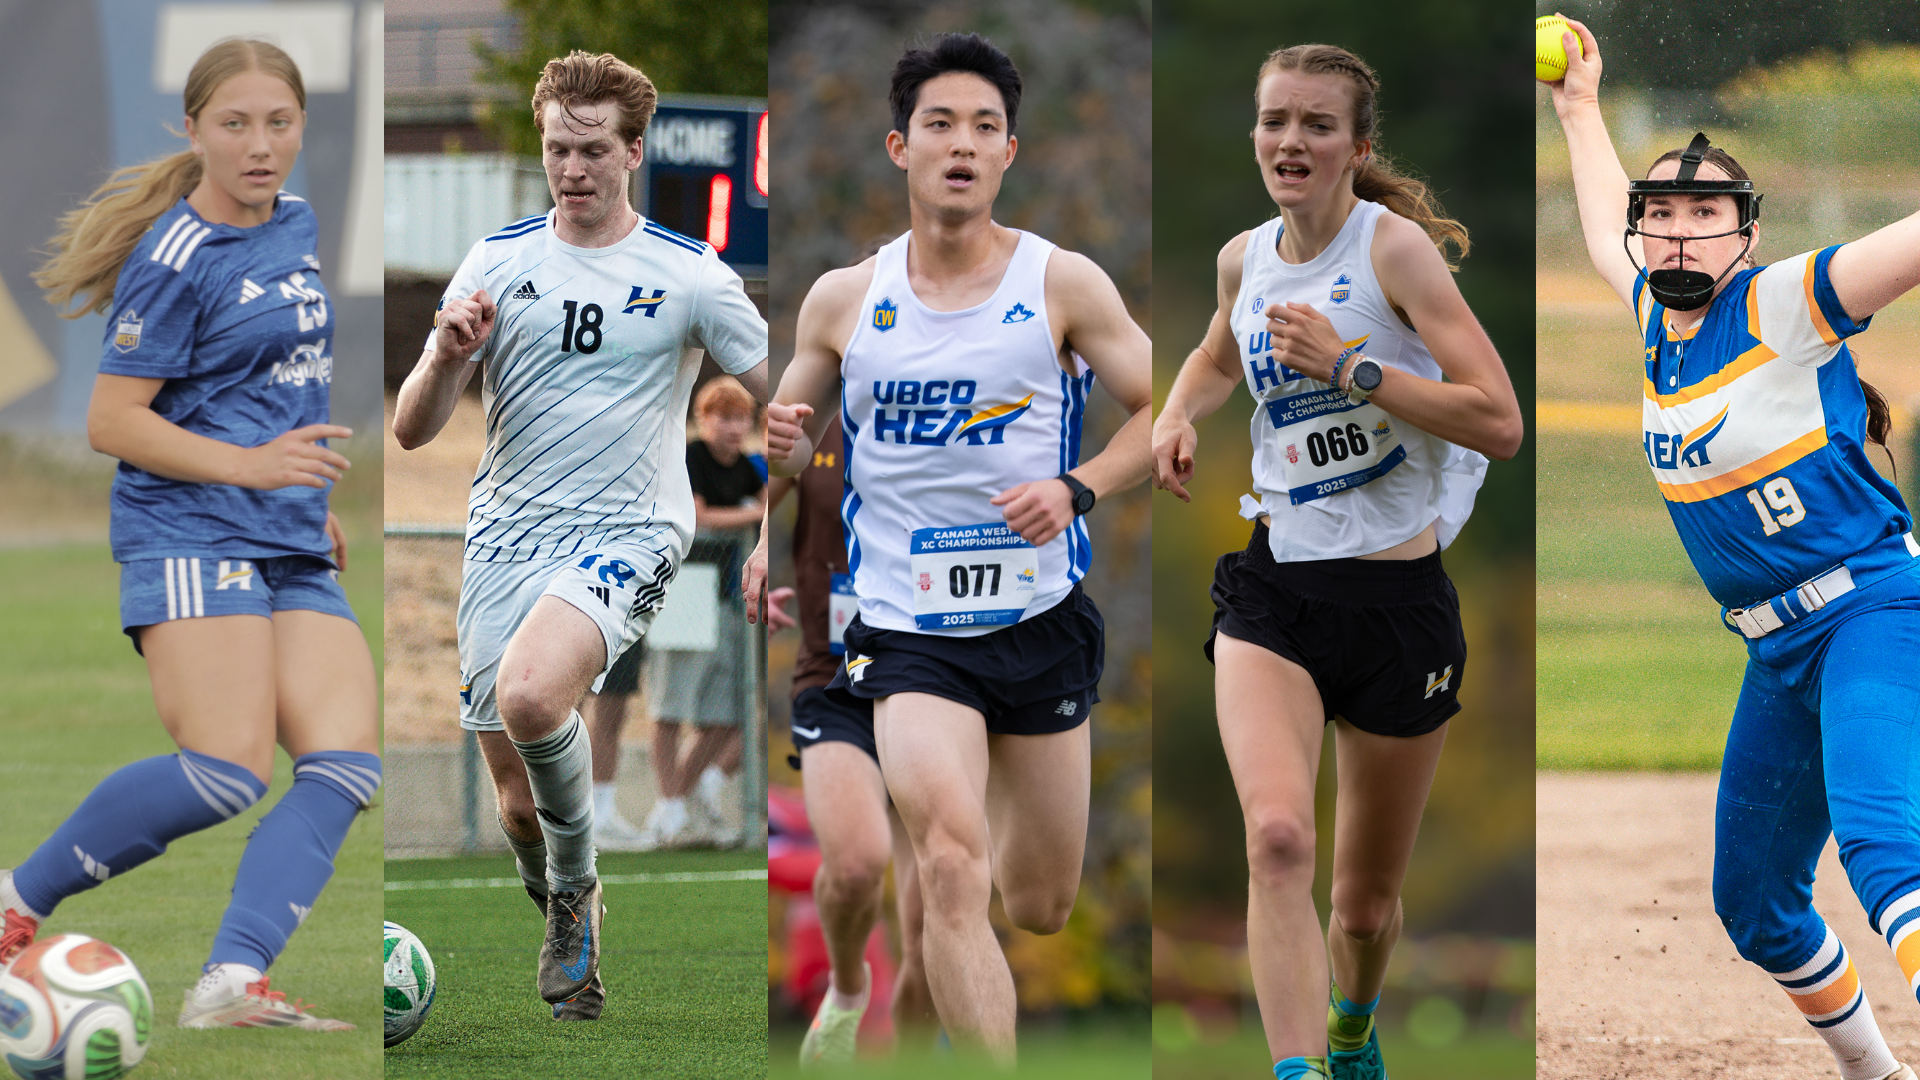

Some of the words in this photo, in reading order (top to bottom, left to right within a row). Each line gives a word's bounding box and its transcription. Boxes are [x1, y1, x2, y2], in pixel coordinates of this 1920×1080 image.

[647, 115, 738, 169] HOME
[280, 271, 328, 333] 25
[512, 292, 541, 301] adidas
[1332, 290, 1349, 300] WEST
[561, 299, 604, 355] 18
[874, 309, 896, 326] CW
[873, 379, 977, 406] UBCO
[1288, 395, 1326, 409] CANADA
[1324, 390, 1348, 402] WES
[874, 391, 1036, 447] HEAT
[1280, 411, 1295, 422] XC
[1295, 398, 1351, 418] CHAMPIONS
[1306, 422, 1370, 467] 066
[1316, 478, 1348, 495] 2025
[1746, 476, 1806, 537] 19
[920, 540, 936, 550] XC
[937, 536, 1028, 549] CHAMPIONSHIPS
[933, 529, 980, 540] CANADA
[981, 526, 1013, 537] WEST
[949, 563, 1002, 598] 077
[942, 613, 975, 626] 2025
